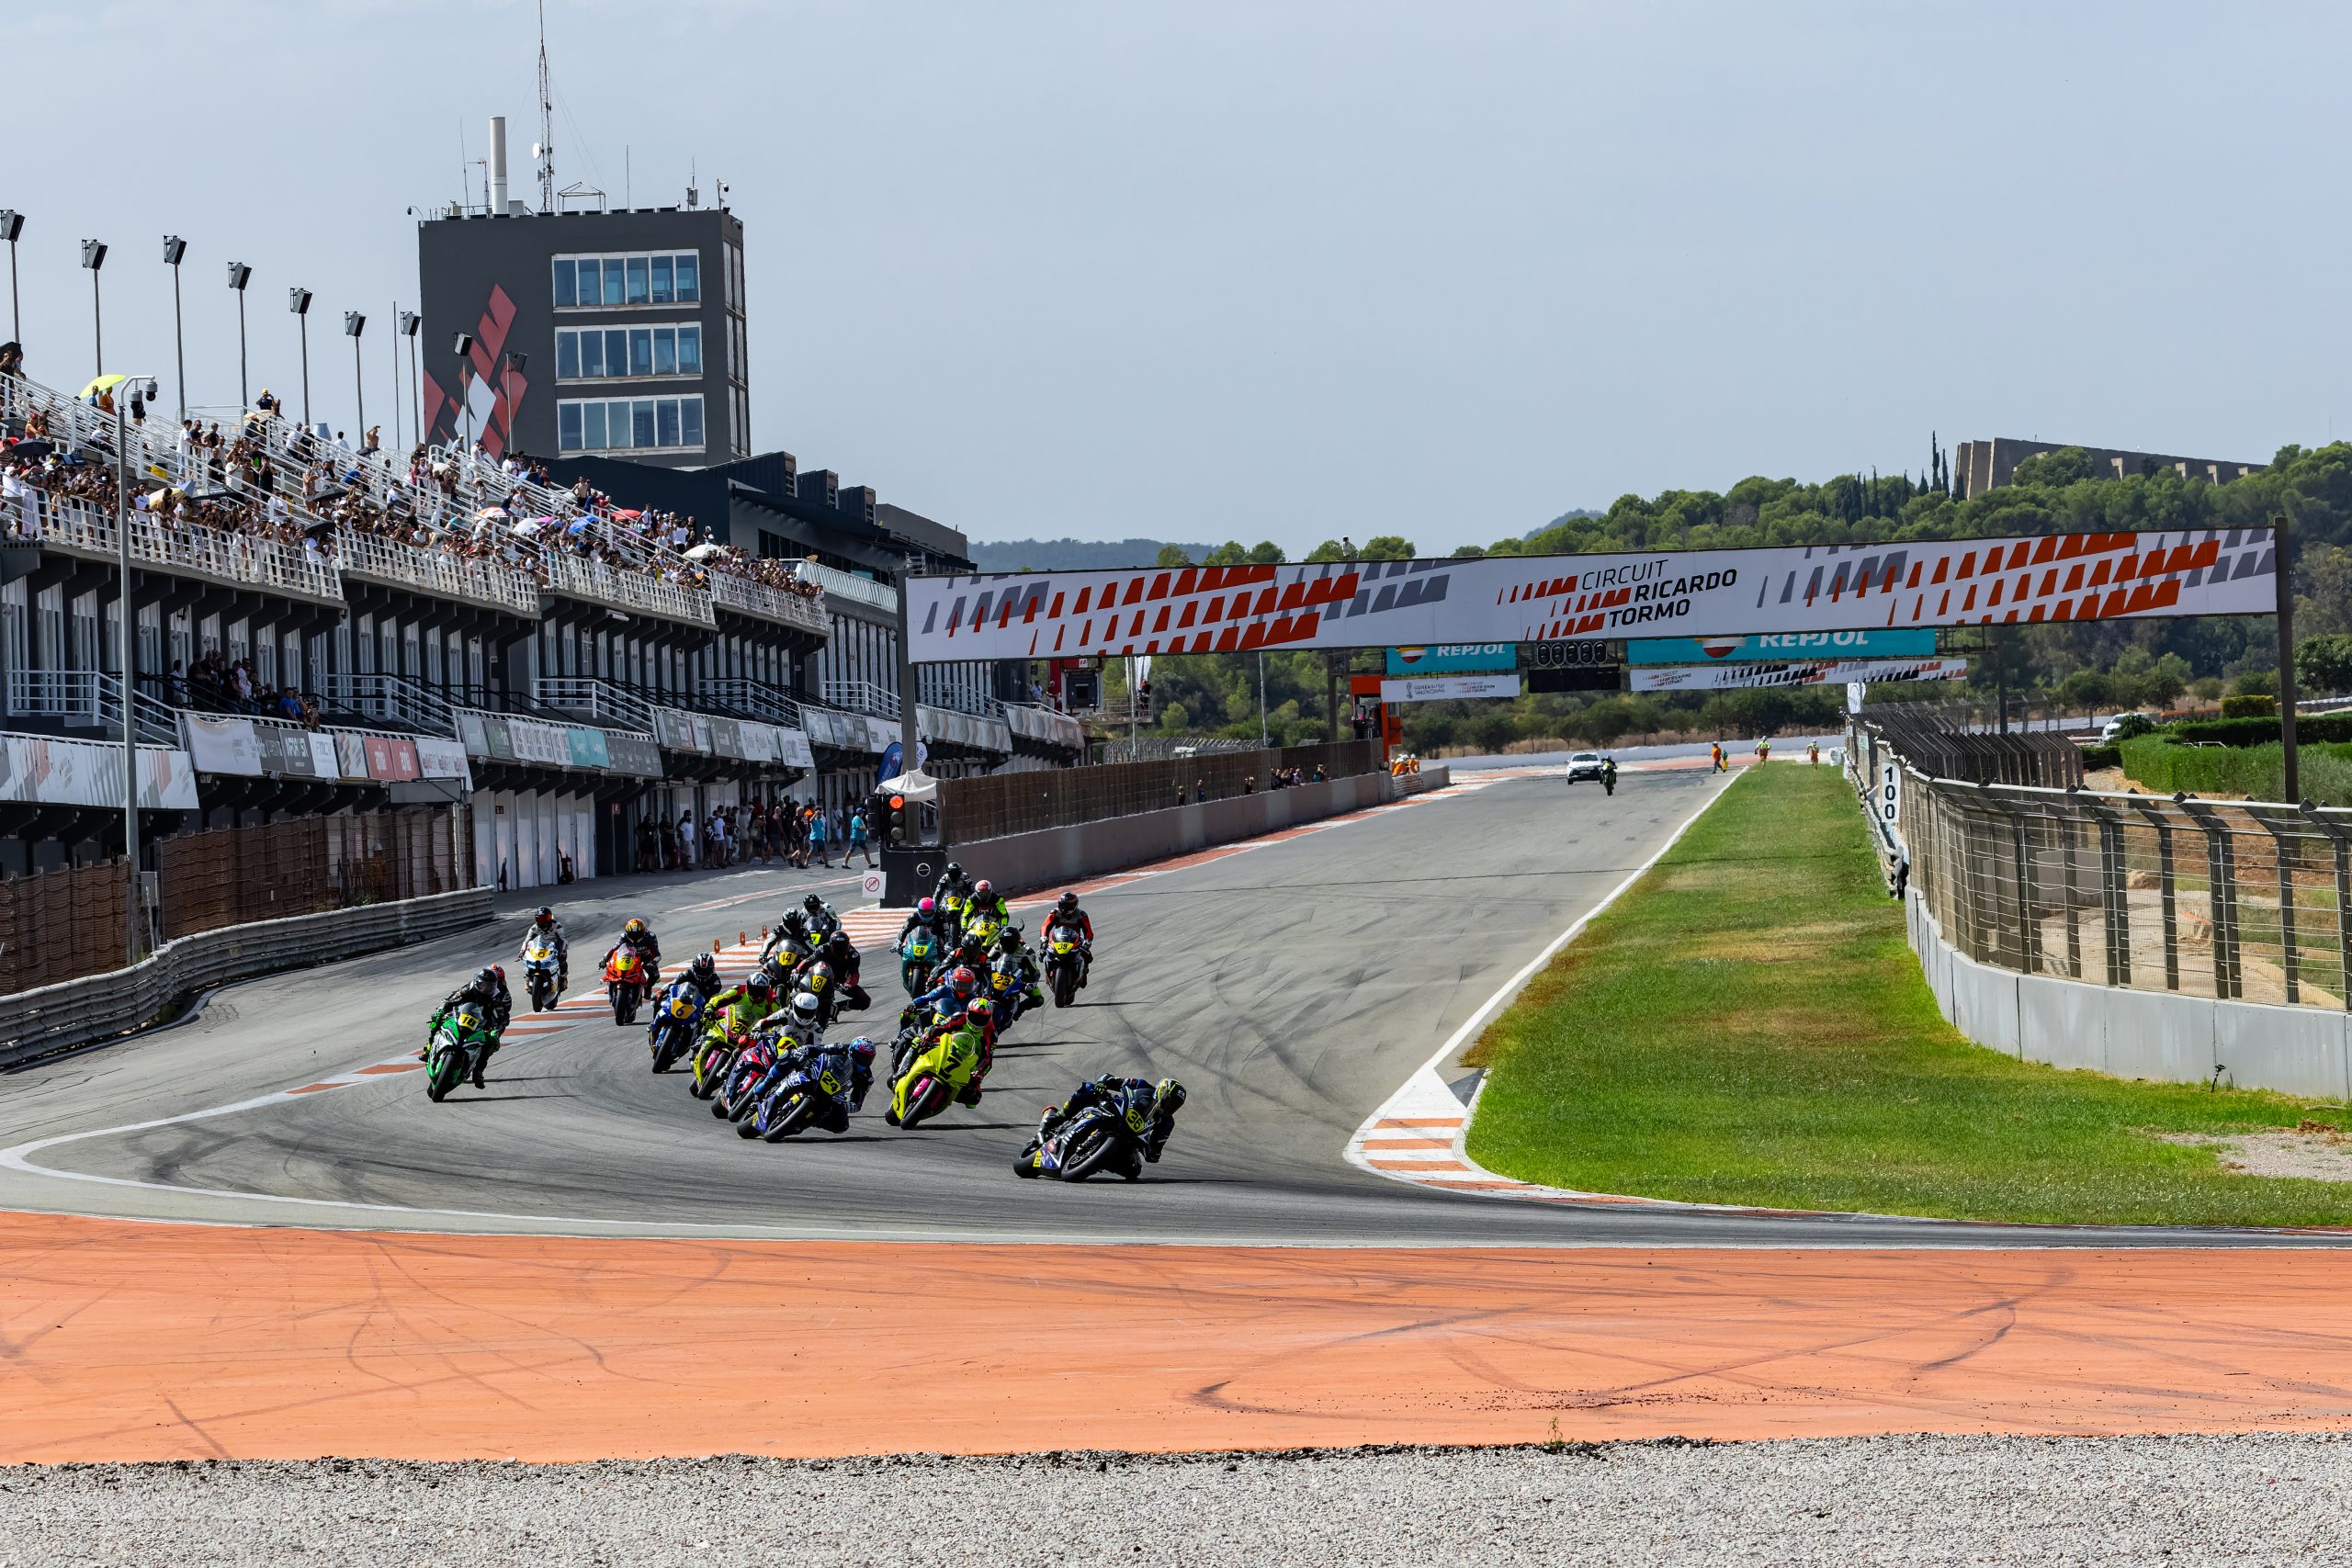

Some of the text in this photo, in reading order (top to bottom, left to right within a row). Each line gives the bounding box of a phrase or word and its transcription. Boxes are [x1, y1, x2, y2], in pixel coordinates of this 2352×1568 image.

[1582, 559, 1668, 590] CIRCUIT
[1634, 569, 1737, 603] RICARDO
[1610, 598, 1690, 627] TORMO
[1759, 631, 1869, 648] REPSOL
[1437, 644, 1506, 657] REPSOL
[1884, 766, 1896, 820] 100
[915, 945, 925, 954] 28
[1057, 942, 1068, 951] 39
[782, 953, 793, 963] 14
[995, 976, 1012, 987] 23
[675, 1006, 684, 1017] 6
[821, 1075, 839, 1092] 24
[1126, 1111, 1143, 1131] 36
